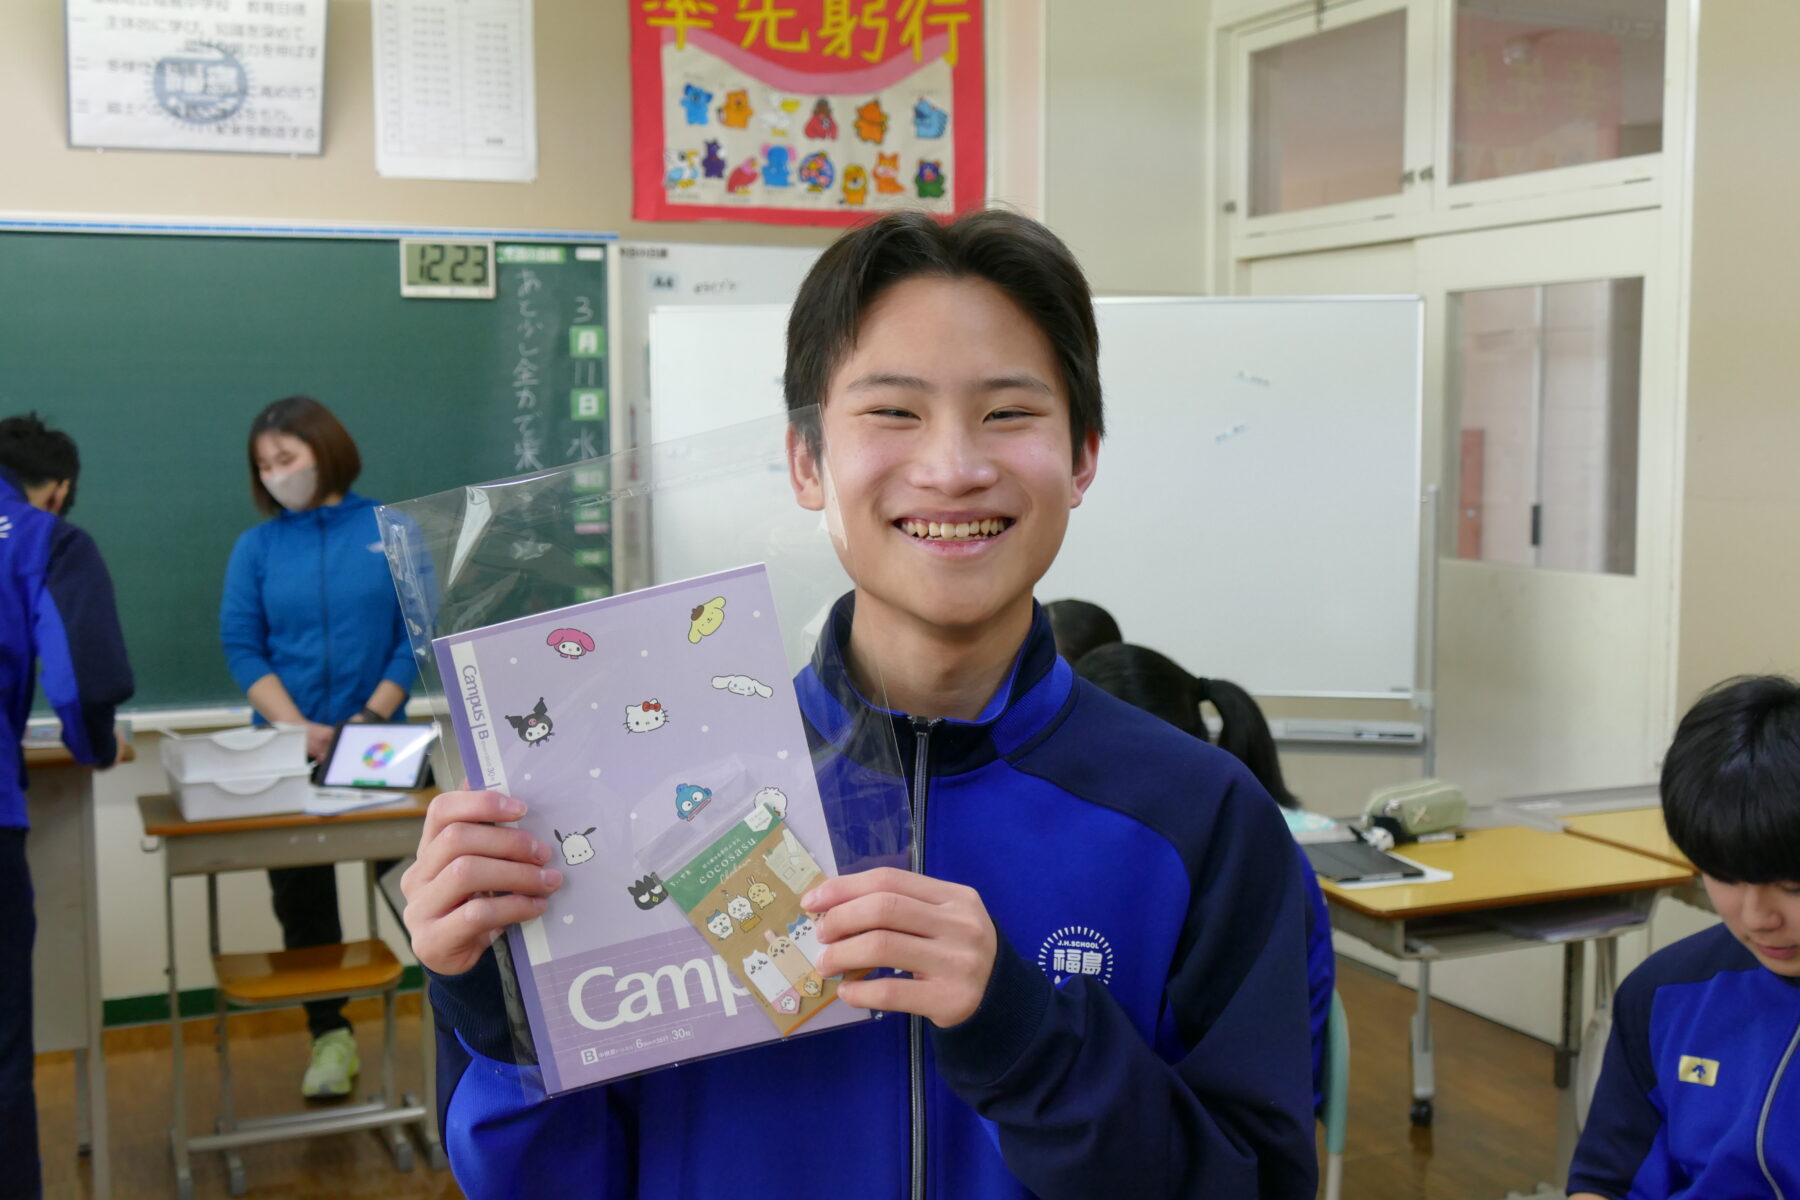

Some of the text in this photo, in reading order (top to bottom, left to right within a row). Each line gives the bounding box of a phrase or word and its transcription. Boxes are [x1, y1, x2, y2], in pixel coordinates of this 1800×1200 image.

[461, 664, 486, 722] Campus
[477, 728, 490, 740] B
[1057, 940, 1100, 949] J.H.SCHOOL
